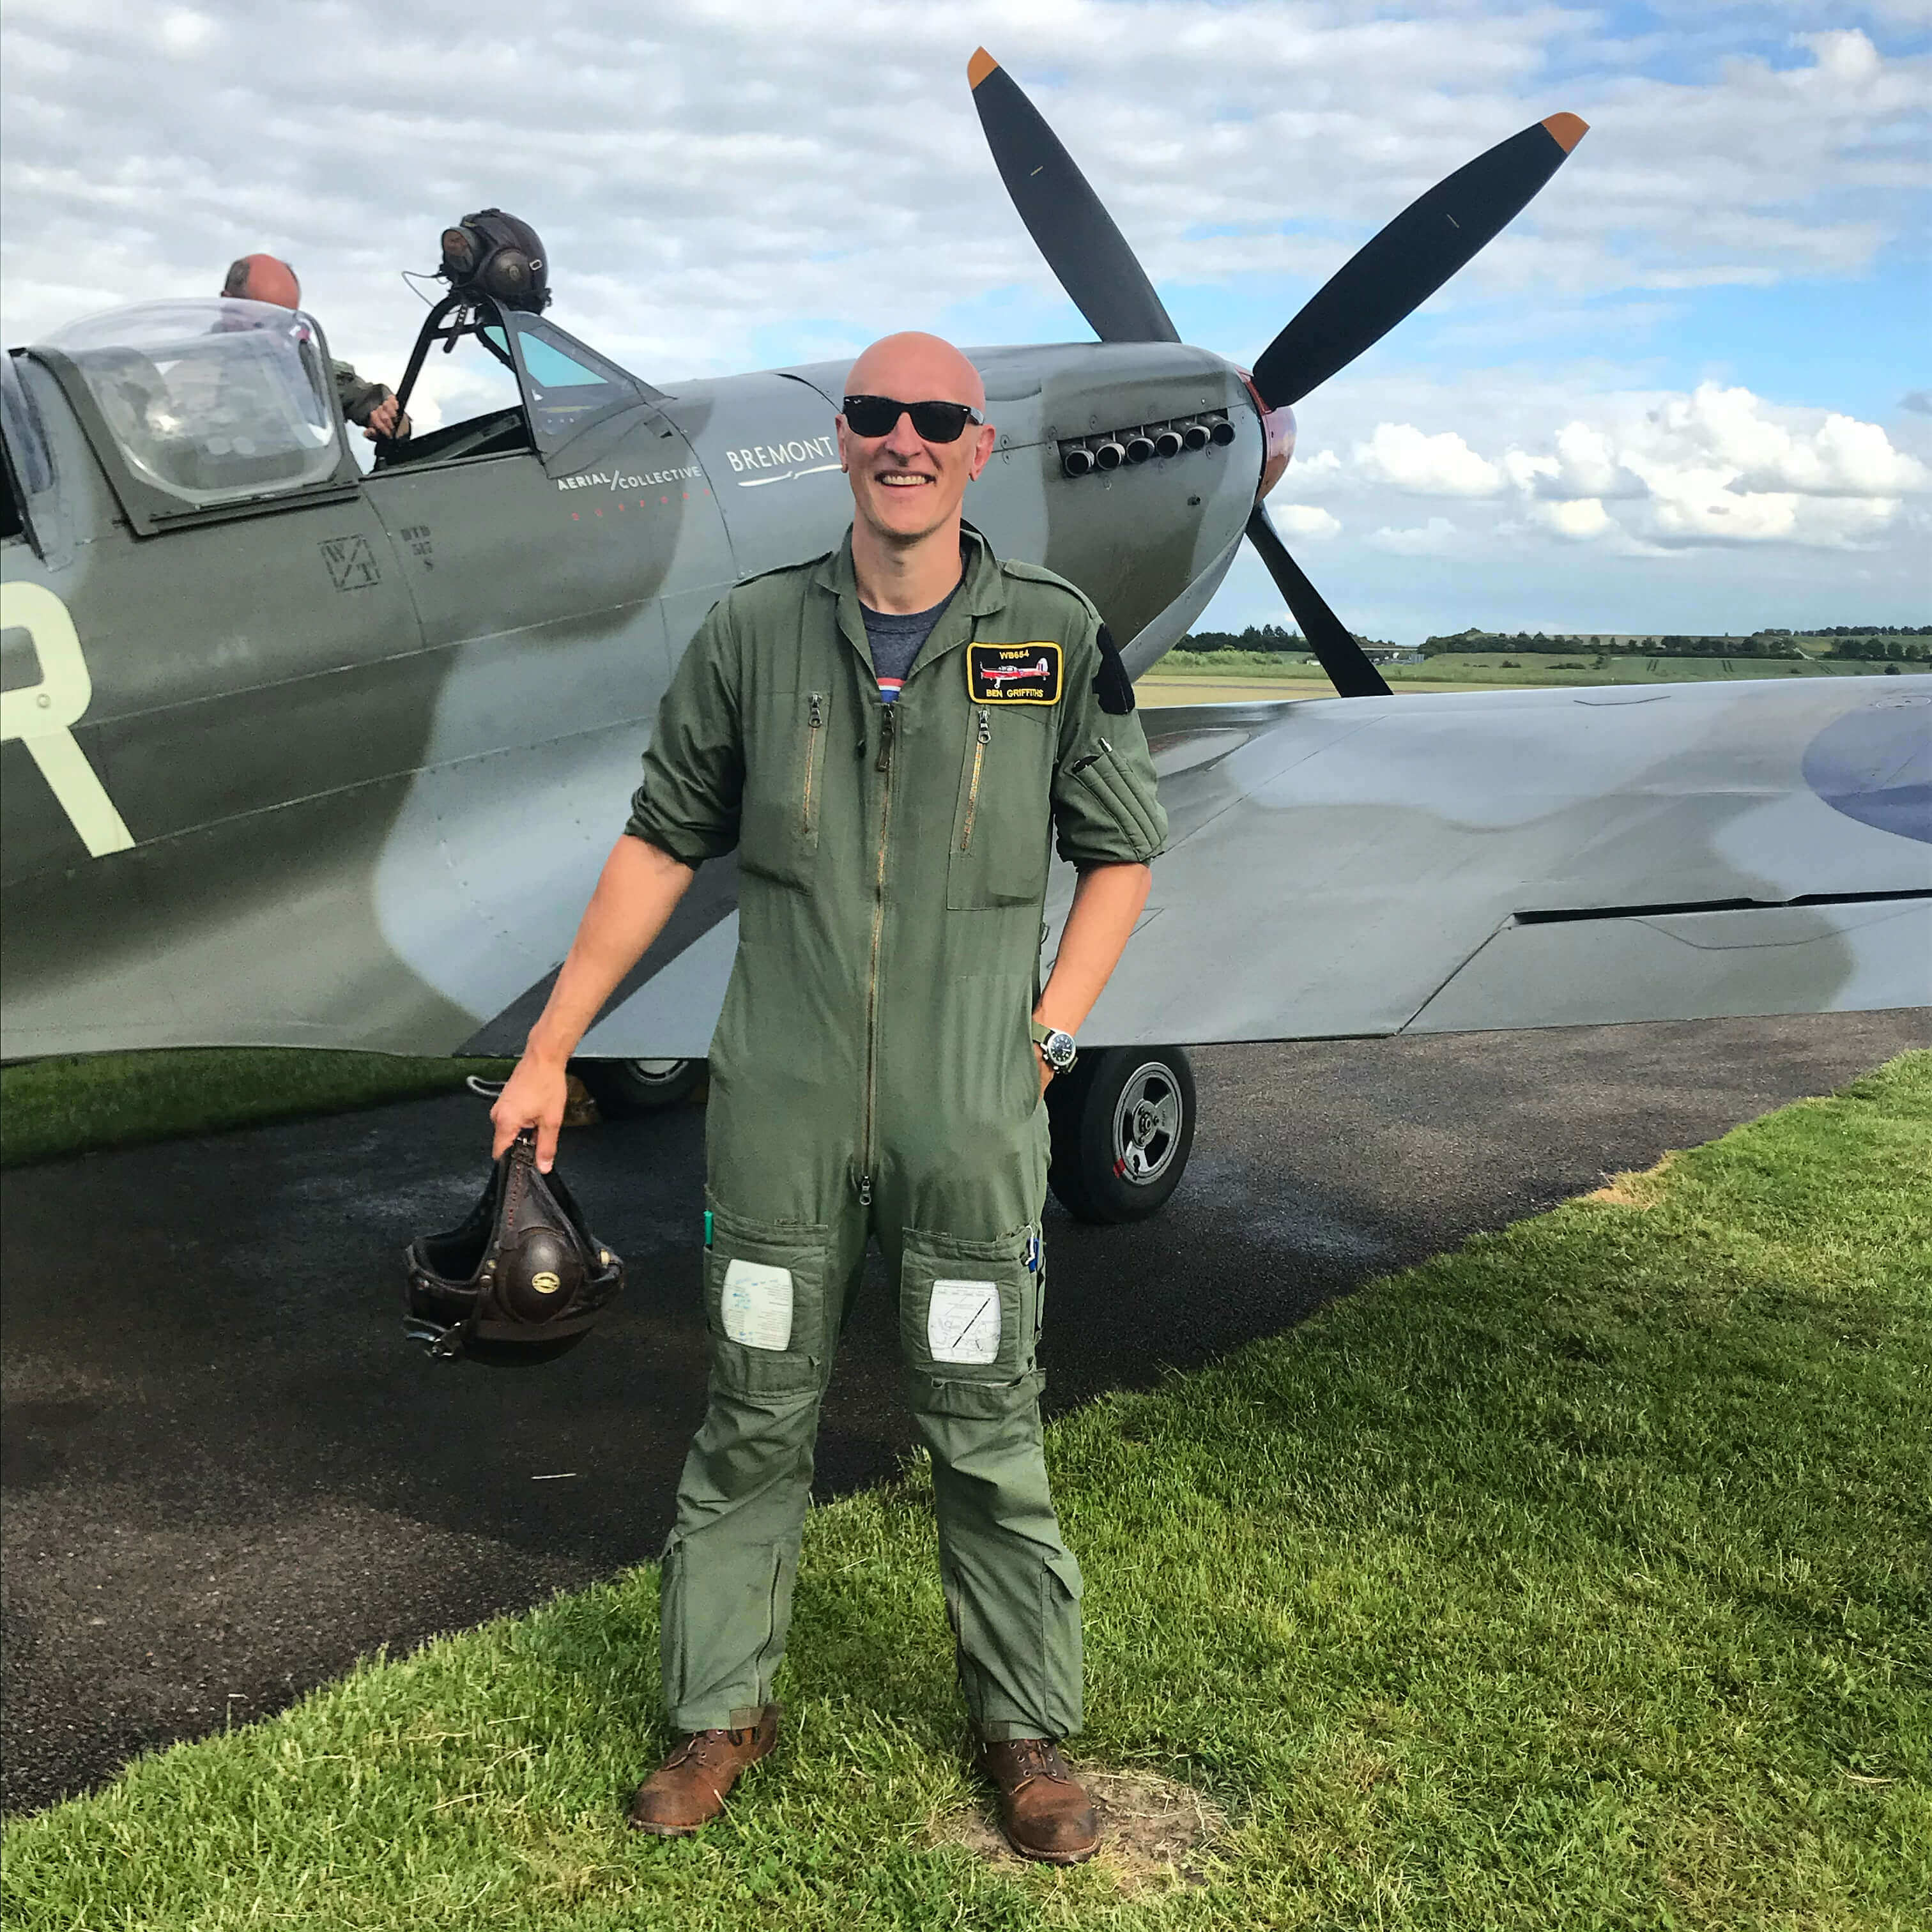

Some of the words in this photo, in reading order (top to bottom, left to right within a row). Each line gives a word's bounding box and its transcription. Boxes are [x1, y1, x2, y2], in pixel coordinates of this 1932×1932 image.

[726, 436, 836, 472] BREMONT
[999, 649, 1030, 660] WB654
[986, 689, 1003, 698] BEN
[1006, 688, 1044, 698] GRIFFITHS
